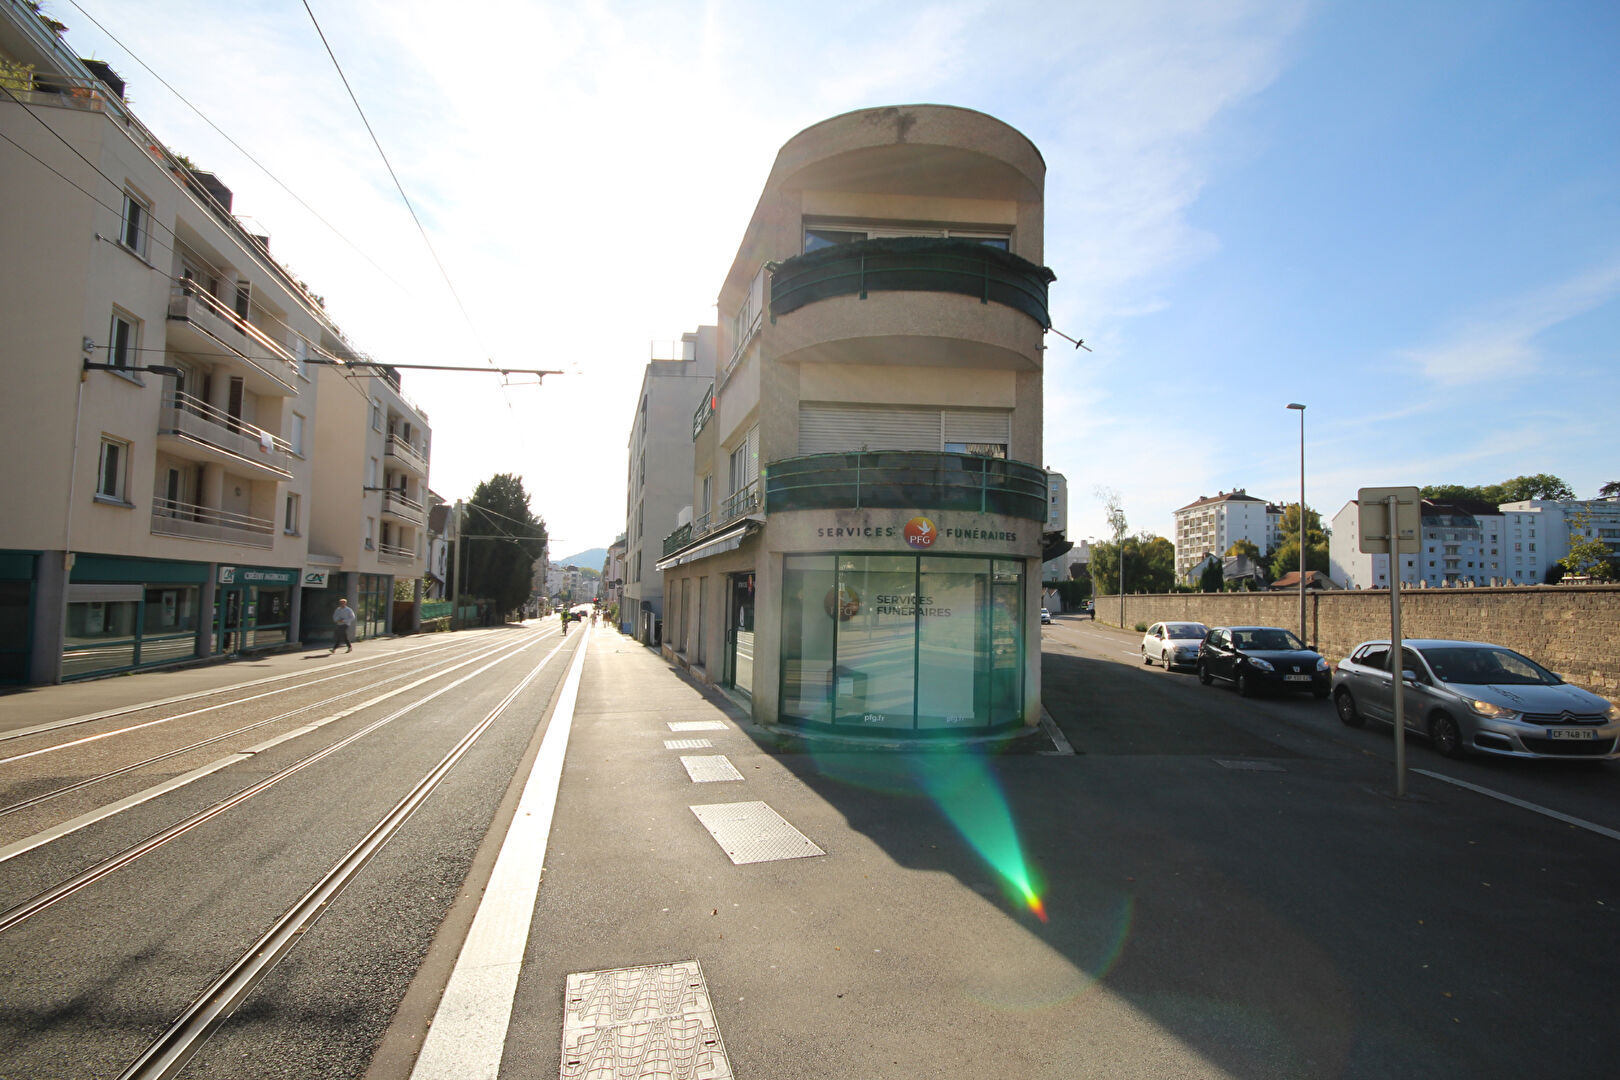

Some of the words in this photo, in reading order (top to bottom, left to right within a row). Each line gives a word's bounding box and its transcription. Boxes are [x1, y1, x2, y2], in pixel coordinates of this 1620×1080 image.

[817, 527, 893, 537] SERVICES
[946, 528, 1017, 541] FUNÉRAIRES
[909, 535, 931, 544] PFG
[876, 594, 934, 605] SERVICES
[864, 714, 885, 722] pfg.fr
